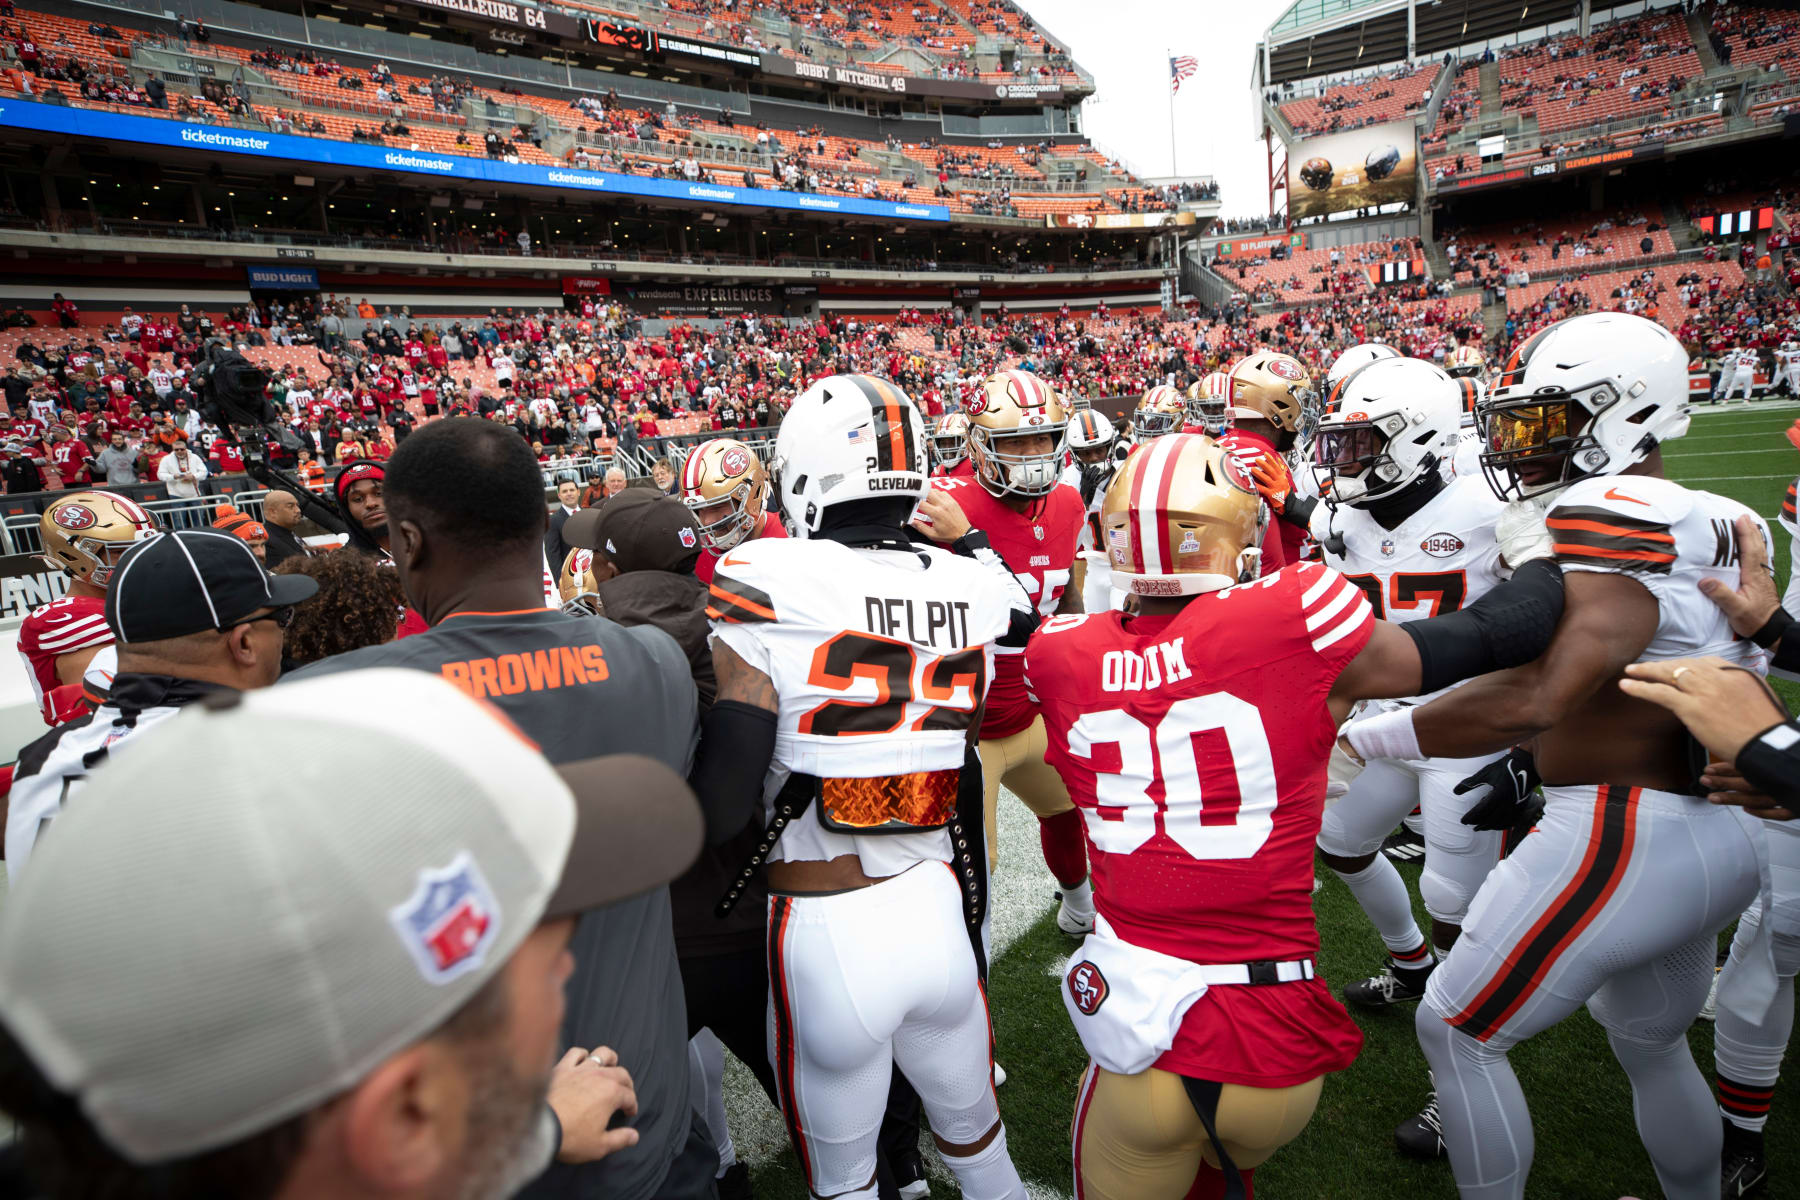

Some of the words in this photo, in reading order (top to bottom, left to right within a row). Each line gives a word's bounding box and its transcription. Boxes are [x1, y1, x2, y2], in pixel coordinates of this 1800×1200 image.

[524, 7, 547, 29] 64
[795, 62, 829, 80] BOBBY
[836, 68, 889, 90] MITCHELL
[891, 77, 906, 92] 49
[1008, 84, 1061, 93] CROSSCOUNTRY
[181, 128, 270, 151] ticketmaster
[385, 153, 454, 172] ticketmaster
[1603, 149, 1634, 163] BROWNS
[548, 172, 605, 187] ticketmaster
[689, 187, 736, 200] ticketmaster
[253, 272, 279, 283] BUD
[281, 273, 313, 284] LIGHT
[685, 287, 773, 302] EXPERIENCES
[163, 328, 173, 339] 16
[156, 376, 169, 387] 19
[722, 409, 735, 420] 52
[55, 447, 71, 463] 97
[868, 477, 923, 492] CLEVELAND
[1428, 539, 1456, 552] 1946
[1029, 555, 1050, 567] 49ERS
[865, 596, 970, 649] DELPIT
[441, 644, 610, 700] BROWNS
[1102, 637, 1192, 692] ODUM
[798, 629, 987, 737] 22
[1067, 690, 1279, 860] 30
